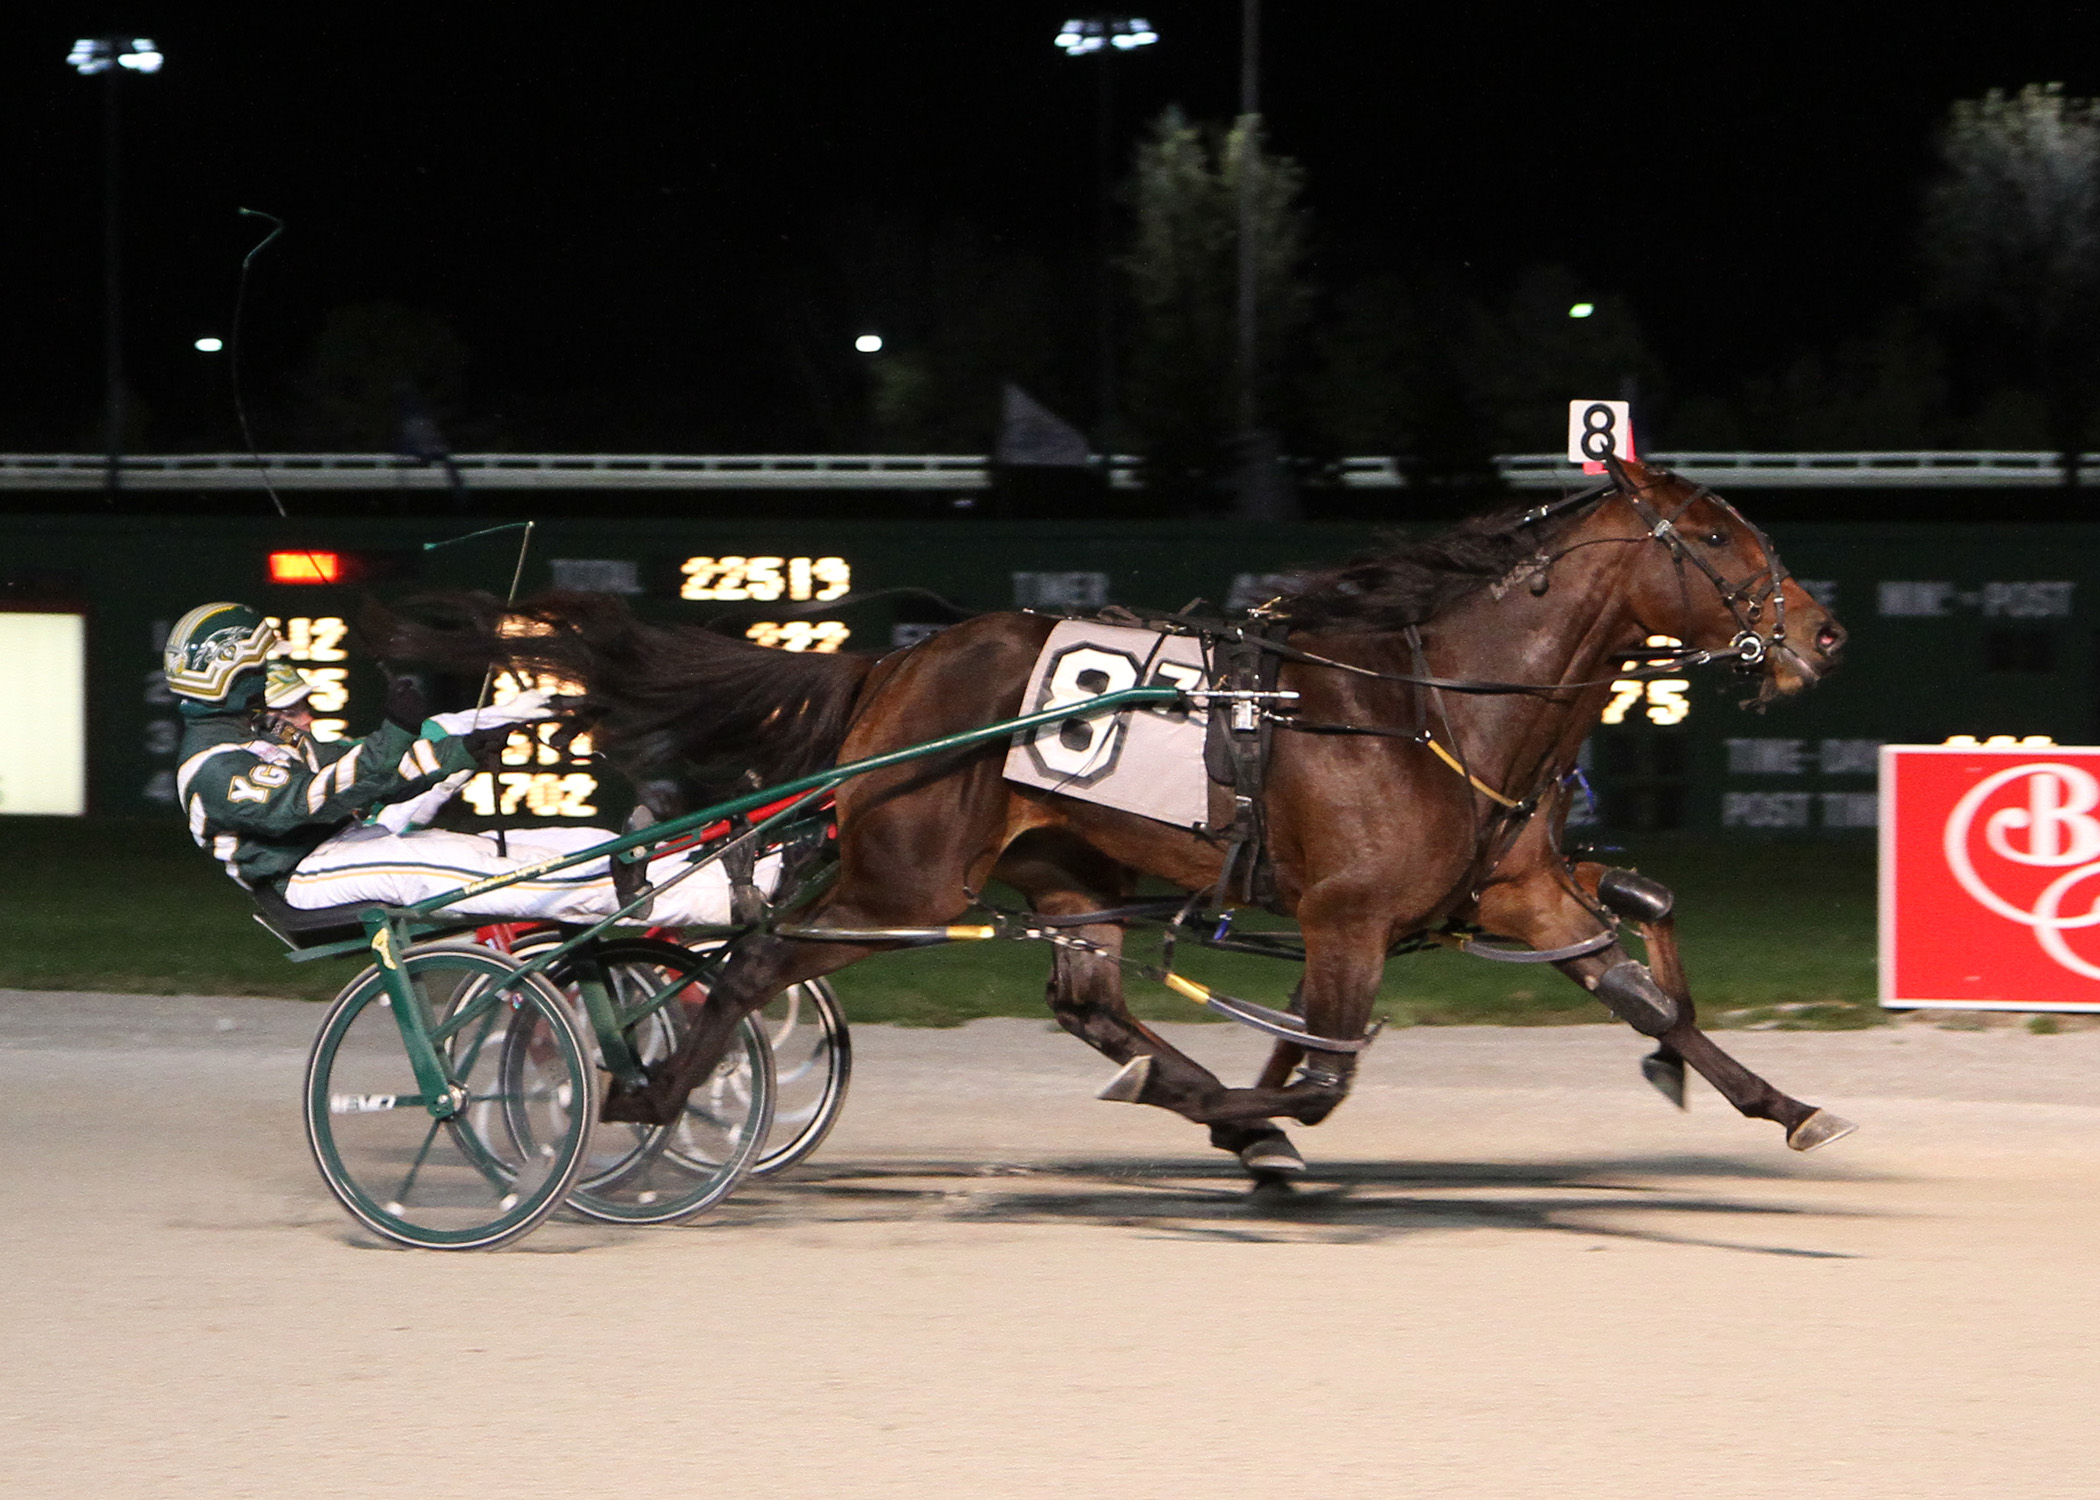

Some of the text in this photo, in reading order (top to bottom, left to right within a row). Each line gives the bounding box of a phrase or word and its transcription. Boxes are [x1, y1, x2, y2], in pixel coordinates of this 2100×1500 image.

[1581, 403, 1616, 461] 8
[1026, 640, 1142, 788] 8
[1601, 679, 1690, 725] 75
[227, 764, 291, 804] YG
